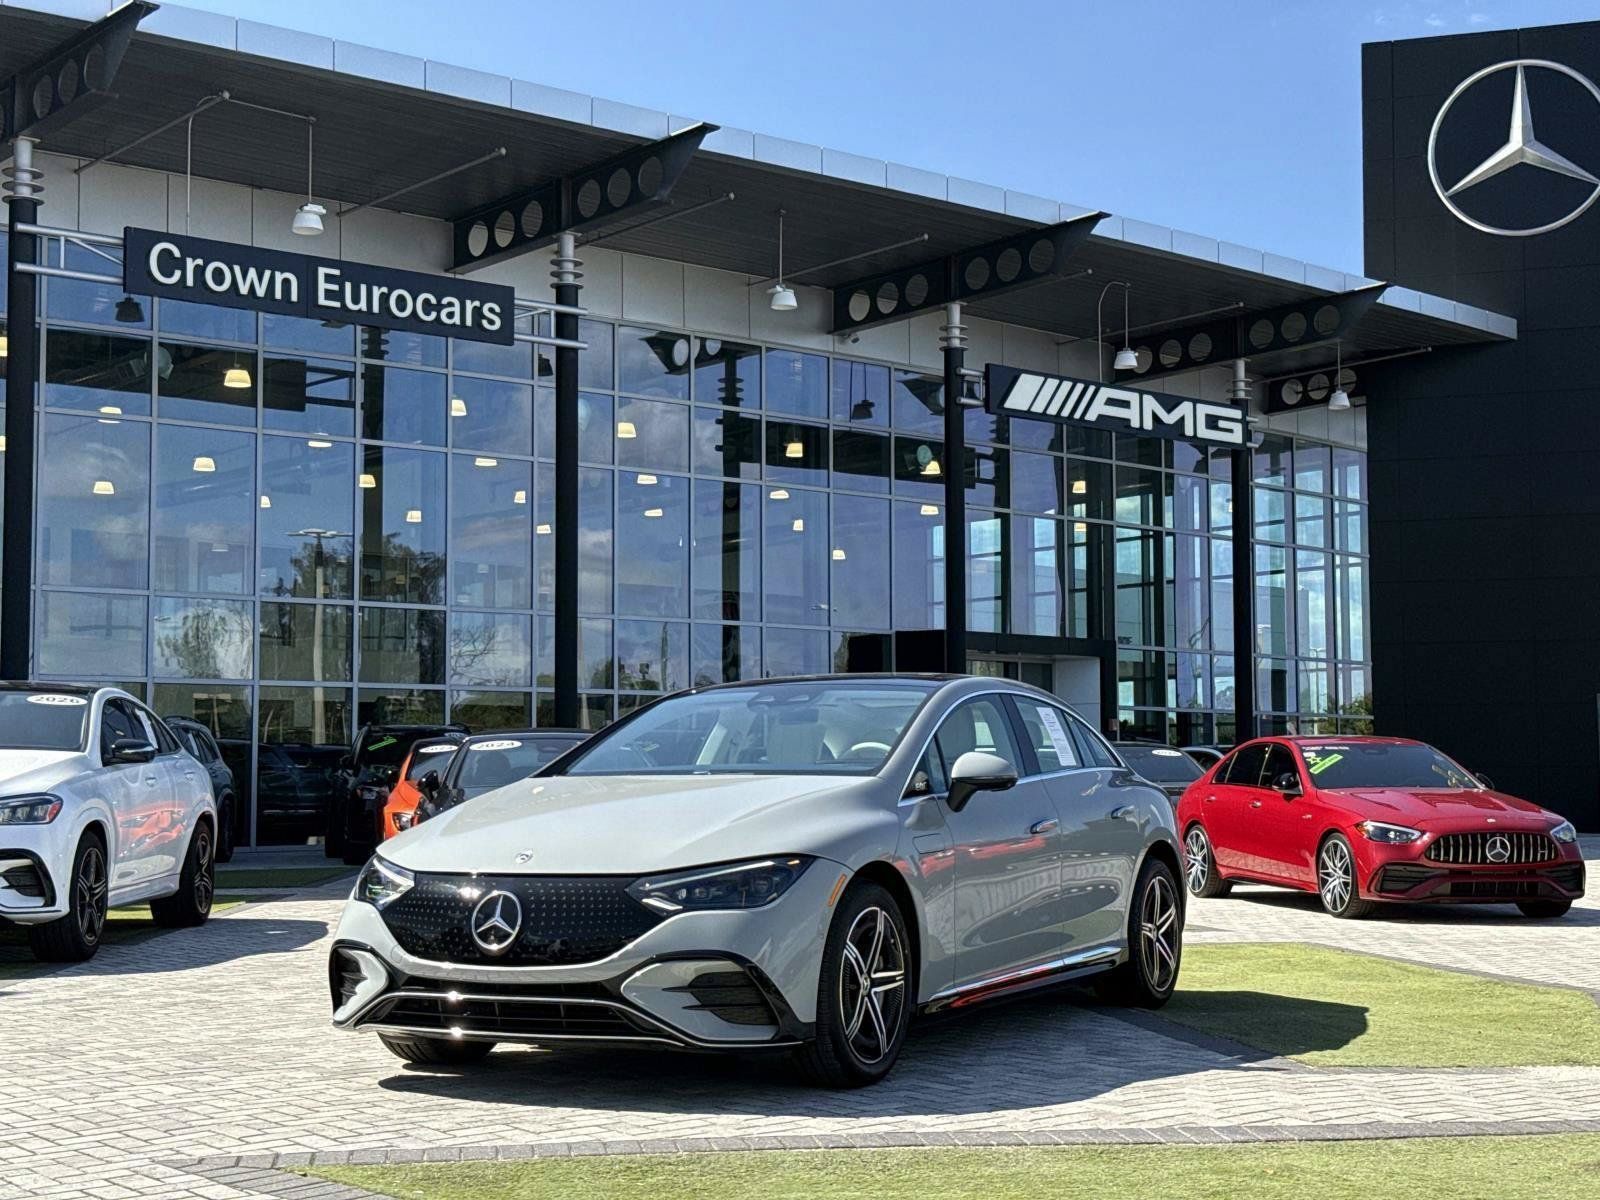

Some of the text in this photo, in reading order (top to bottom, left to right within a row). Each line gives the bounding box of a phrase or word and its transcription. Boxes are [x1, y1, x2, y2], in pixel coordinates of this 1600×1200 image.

[149, 242, 502, 331] Crown Eurocars
[1084, 386, 1243, 444] AMG
